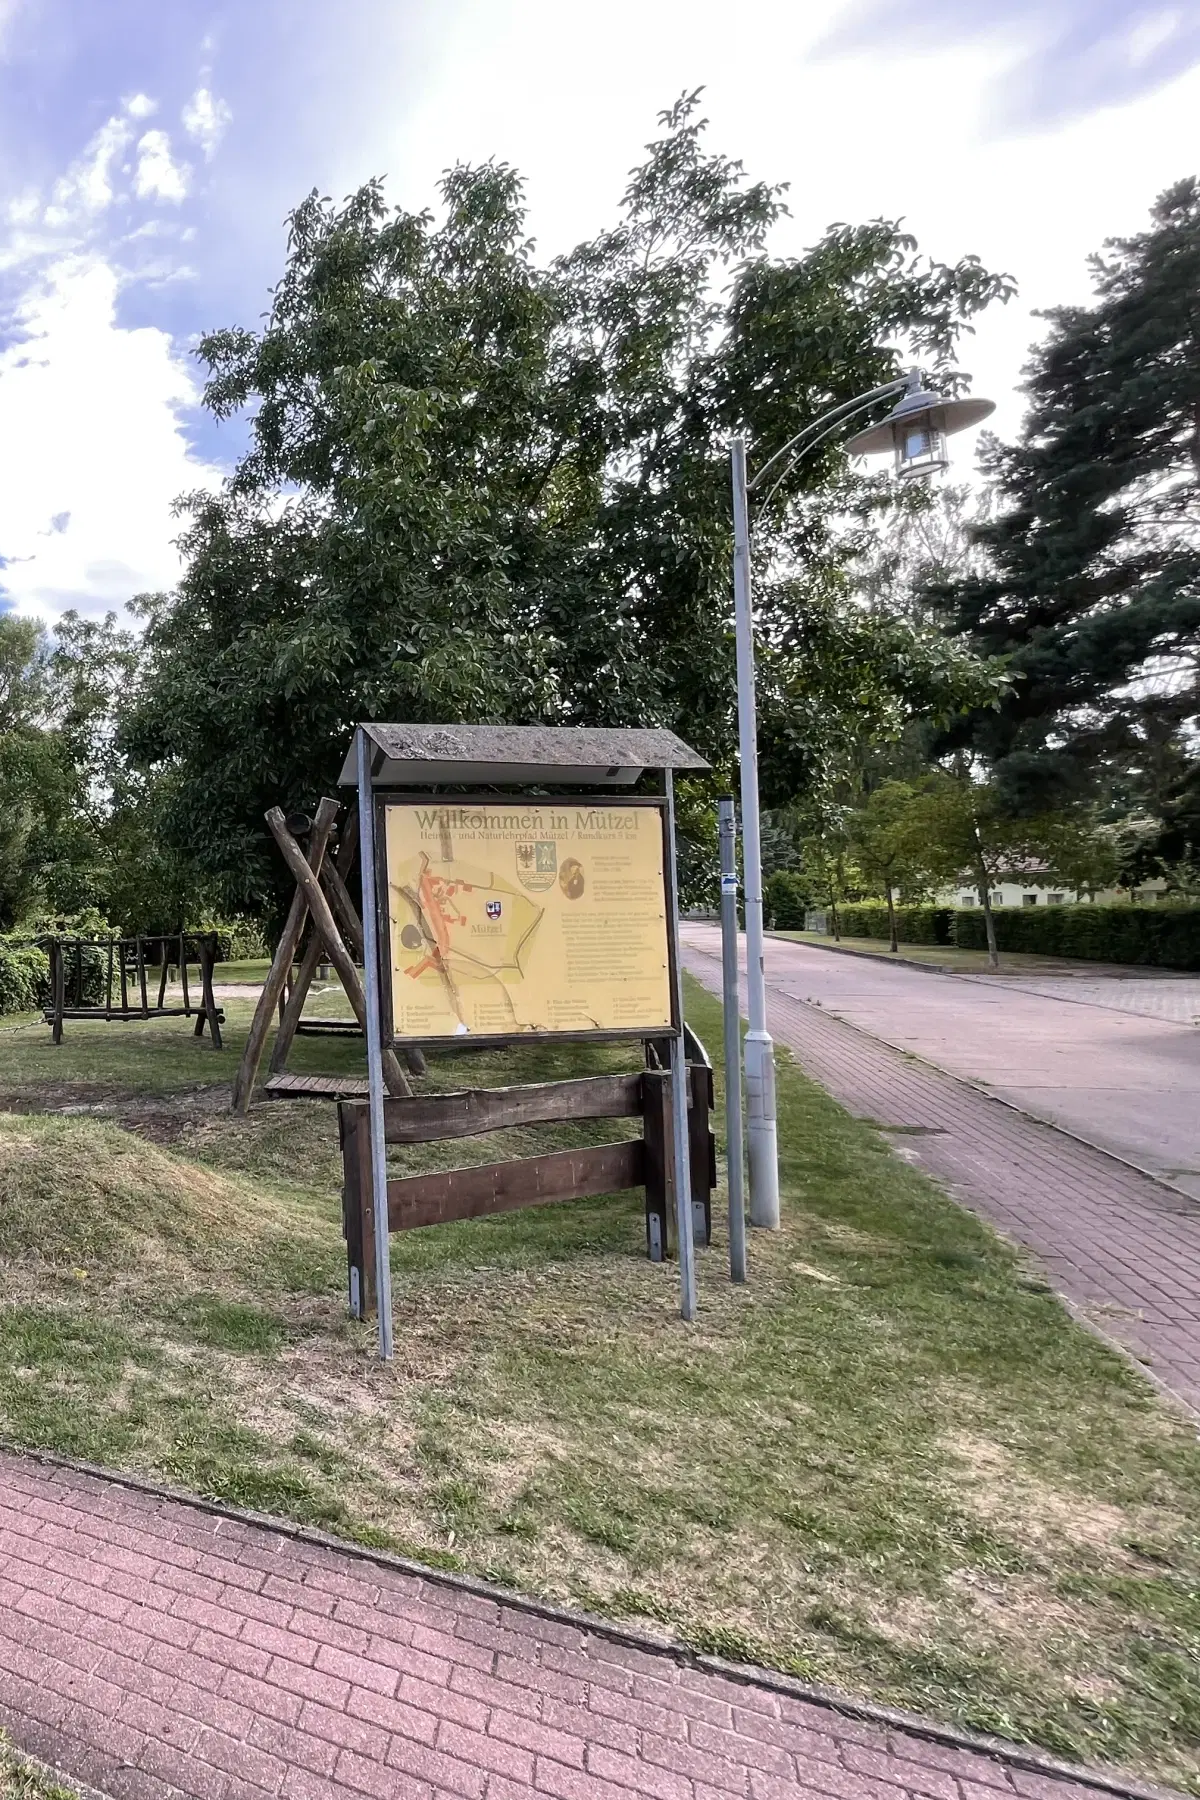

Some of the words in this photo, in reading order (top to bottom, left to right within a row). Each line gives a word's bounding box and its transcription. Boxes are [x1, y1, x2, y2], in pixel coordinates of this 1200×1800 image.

[414, 809, 544, 829] Willkommen
[550, 810, 569, 830] in
[575, 809, 640, 830] Mützel
[459, 831, 476, 840] und
[478, 831, 537, 842] Naturlehrpfad
[540, 831, 568, 840] Mützel
